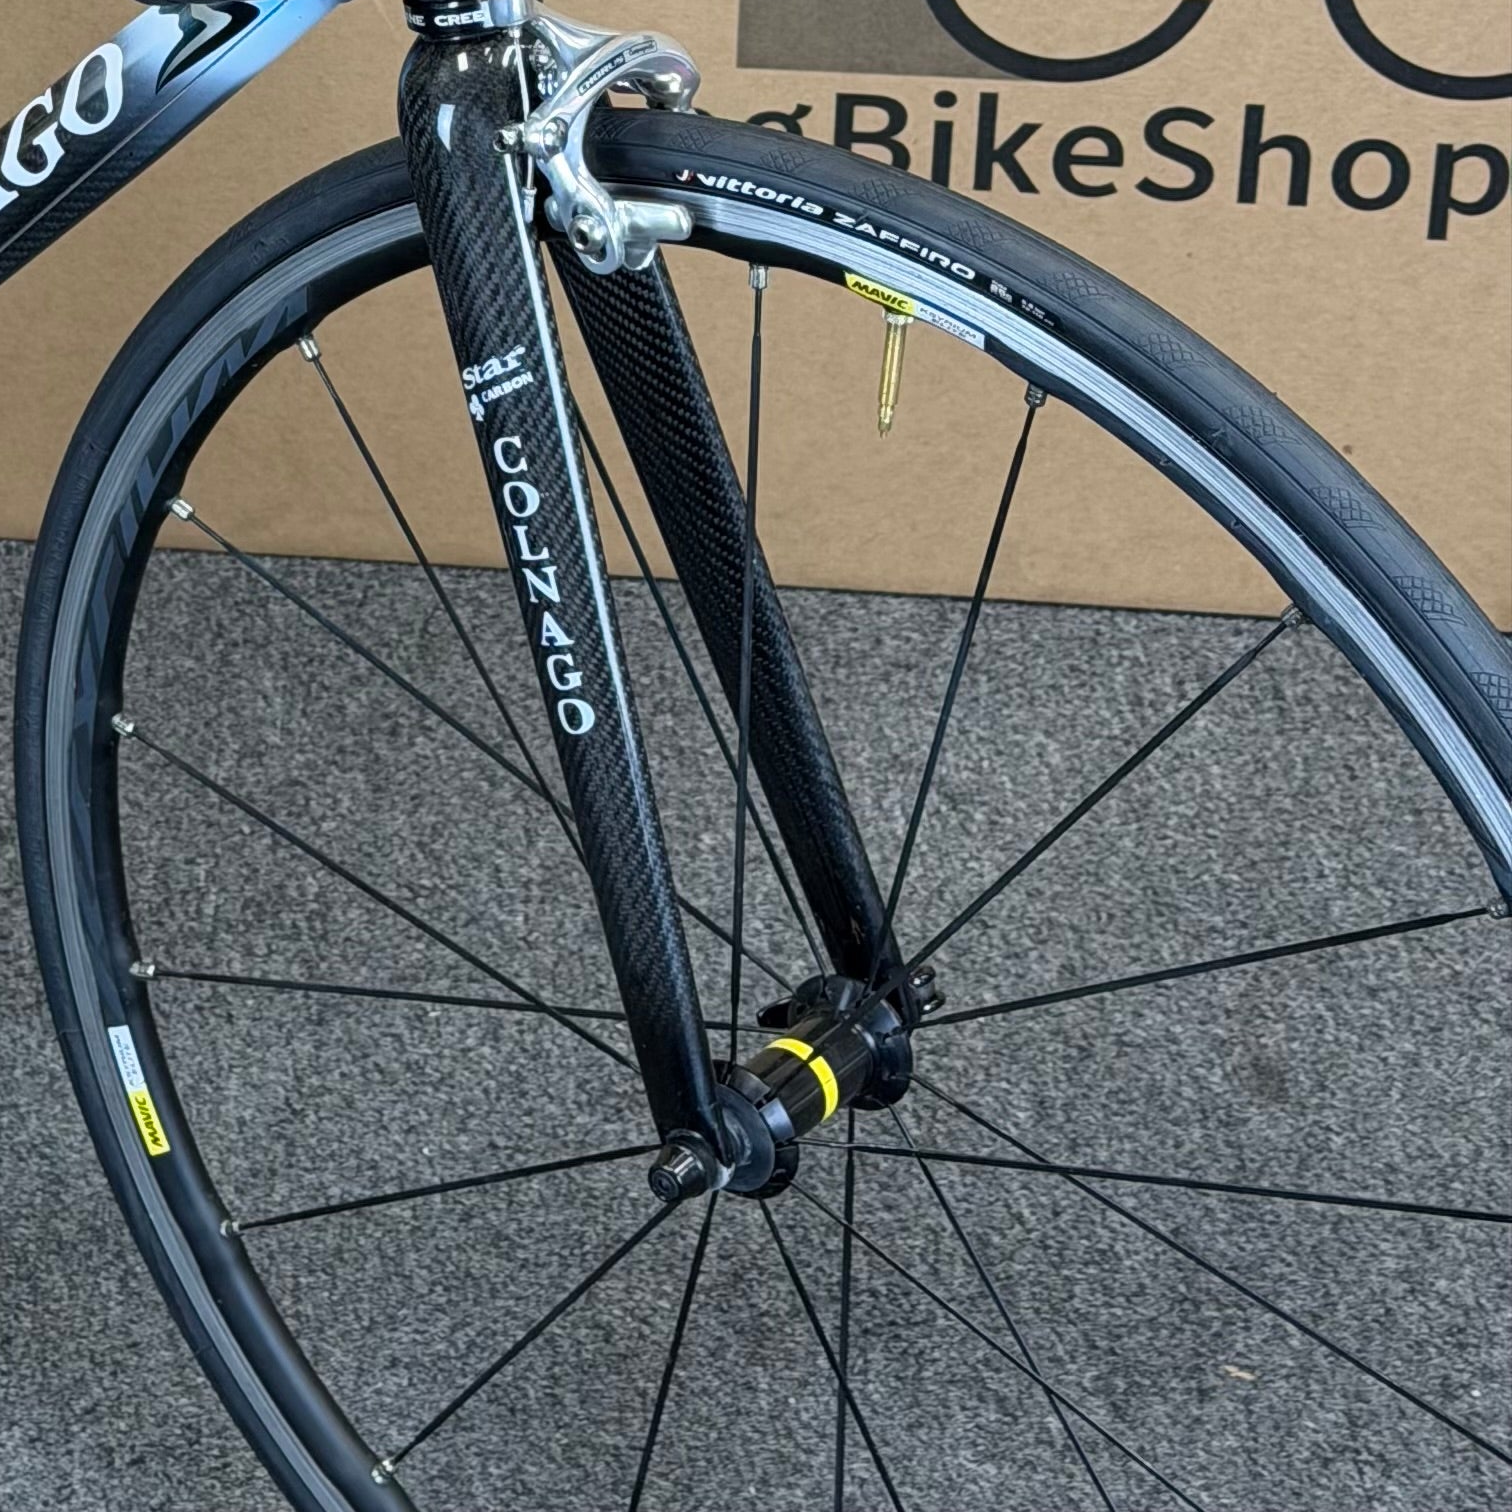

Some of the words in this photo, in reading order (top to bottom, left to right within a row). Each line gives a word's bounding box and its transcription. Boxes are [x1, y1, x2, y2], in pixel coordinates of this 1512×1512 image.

[696, 173, 824, 215] vittoria
[832, 211, 977, 282] ZAFFIRO
[850, 279, 910, 312] MAVIC
[462, 344, 526, 390] Star
[481, 371, 534, 402] CARBON
[492, 435, 596, 735] COLNAGO
[134, 1095, 164, 1148] MAVIC
